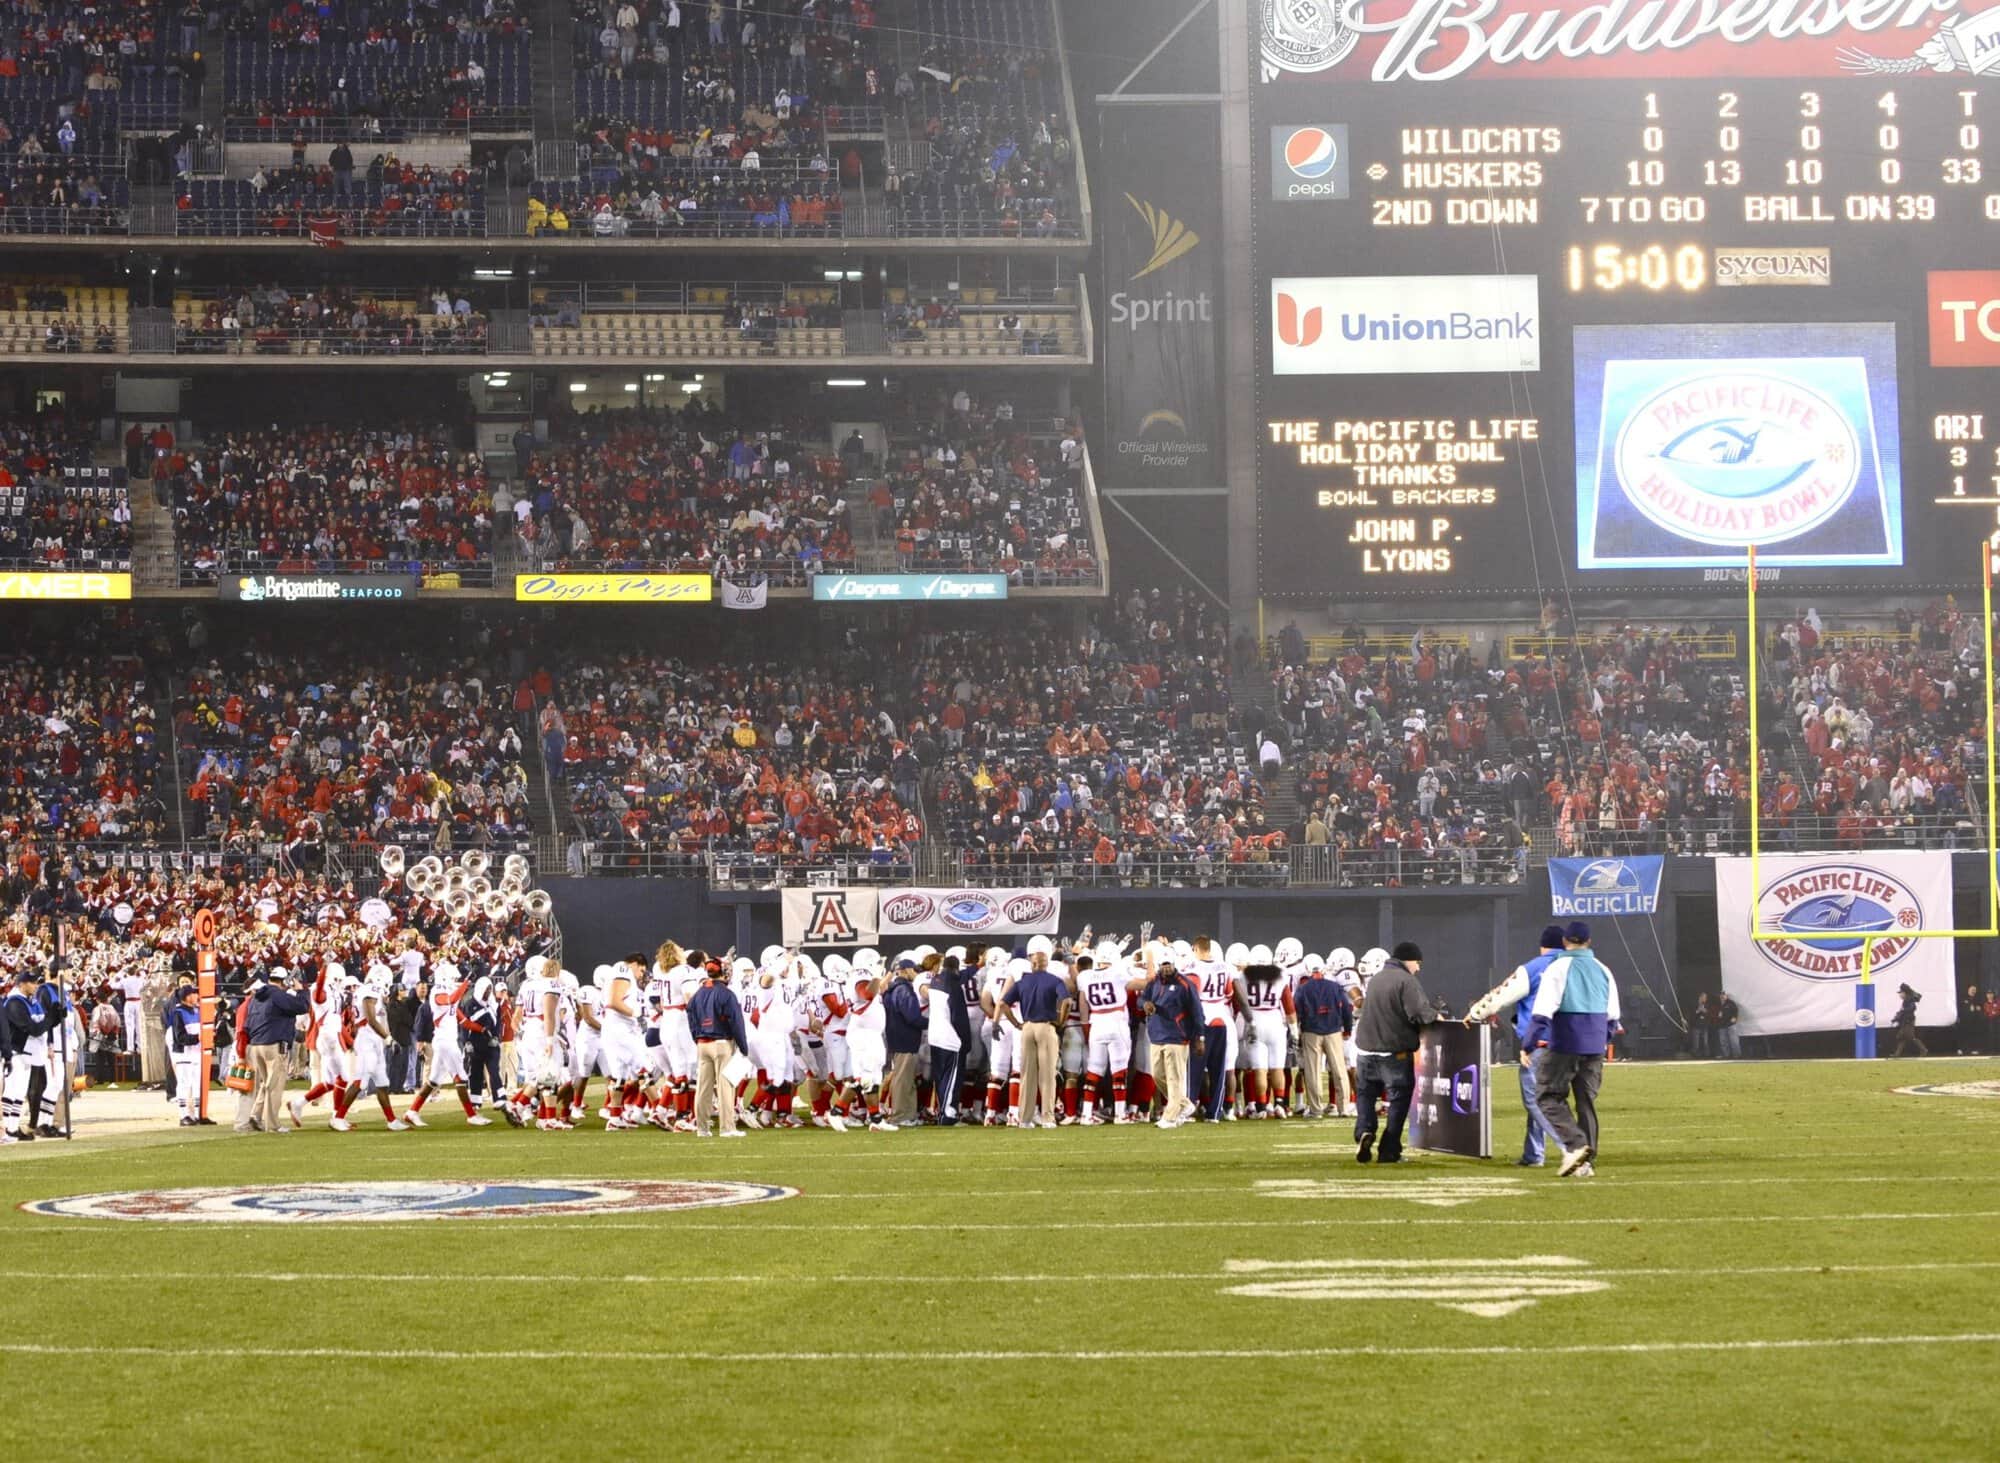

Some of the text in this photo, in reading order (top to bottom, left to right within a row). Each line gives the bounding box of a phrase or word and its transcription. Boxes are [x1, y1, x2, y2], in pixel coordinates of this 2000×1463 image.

[1645, 91, 1977, 118] 1 2 3 4 T
[1402, 124, 1979, 154] WILDCATS 0 0 0 0 0
[1403, 158, 1981, 188] HUSKERS 10 13 10 0 33
[1288, 180, 1334, 197] pepsi
[1372, 200, 1432, 225] 2ND
[1447, 199, 1538, 225] DOWN
[1580, 198, 1599, 223] 7
[1606, 198, 1652, 223] TO
[1660, 197, 1705, 222] GO
[1744, 196, 1835, 222] BALL
[1846, 195, 1891, 221] ON
[1897, 195, 1935, 220] 39
[1568, 245, 1705, 291] 15:00
[1717, 254, 1829, 277] SYCUAN
[1110, 291, 1211, 331] Sprint
[1653, 384, 1819, 431] PACIFIC LIFE
[1269, 419, 1539, 443] THE PACIFIC LIFE
[1935, 414, 1984, 440] ARI
[1118, 440, 1159, 454] Official
[1300, 442, 1504, 464] HOLIDAY BOWL
[1950, 446, 1968, 467] 3
[1142, 454, 1189, 466] Provider
[1353, 465, 1457, 485] THANKS
[1953, 475, 1966, 496] 1
[1318, 488, 1496, 506] BOWL BACKERS
[1640, 473, 1837, 530] HOLIDAY BOWL
[1349, 518, 1462, 543] JOHN P.
[1363, 549, 1451, 573] LYONS
[265, 576, 402, 600] Brigantine SEAFOOD
[615, 577, 701, 597] Pizza
[844, 580, 996, 598] Degree Degree
[1773, 871, 1897, 907] PACIFIC LIFE
[1551, 894, 1622, 914] PACIFIC
[804, 891, 858, 943] A
[1764, 937, 1852, 974] HOLIDAY
[1087, 982, 1117, 1007] 63
[1203, 972, 1227, 998] 48
[1247, 980, 1277, 1007] 94
